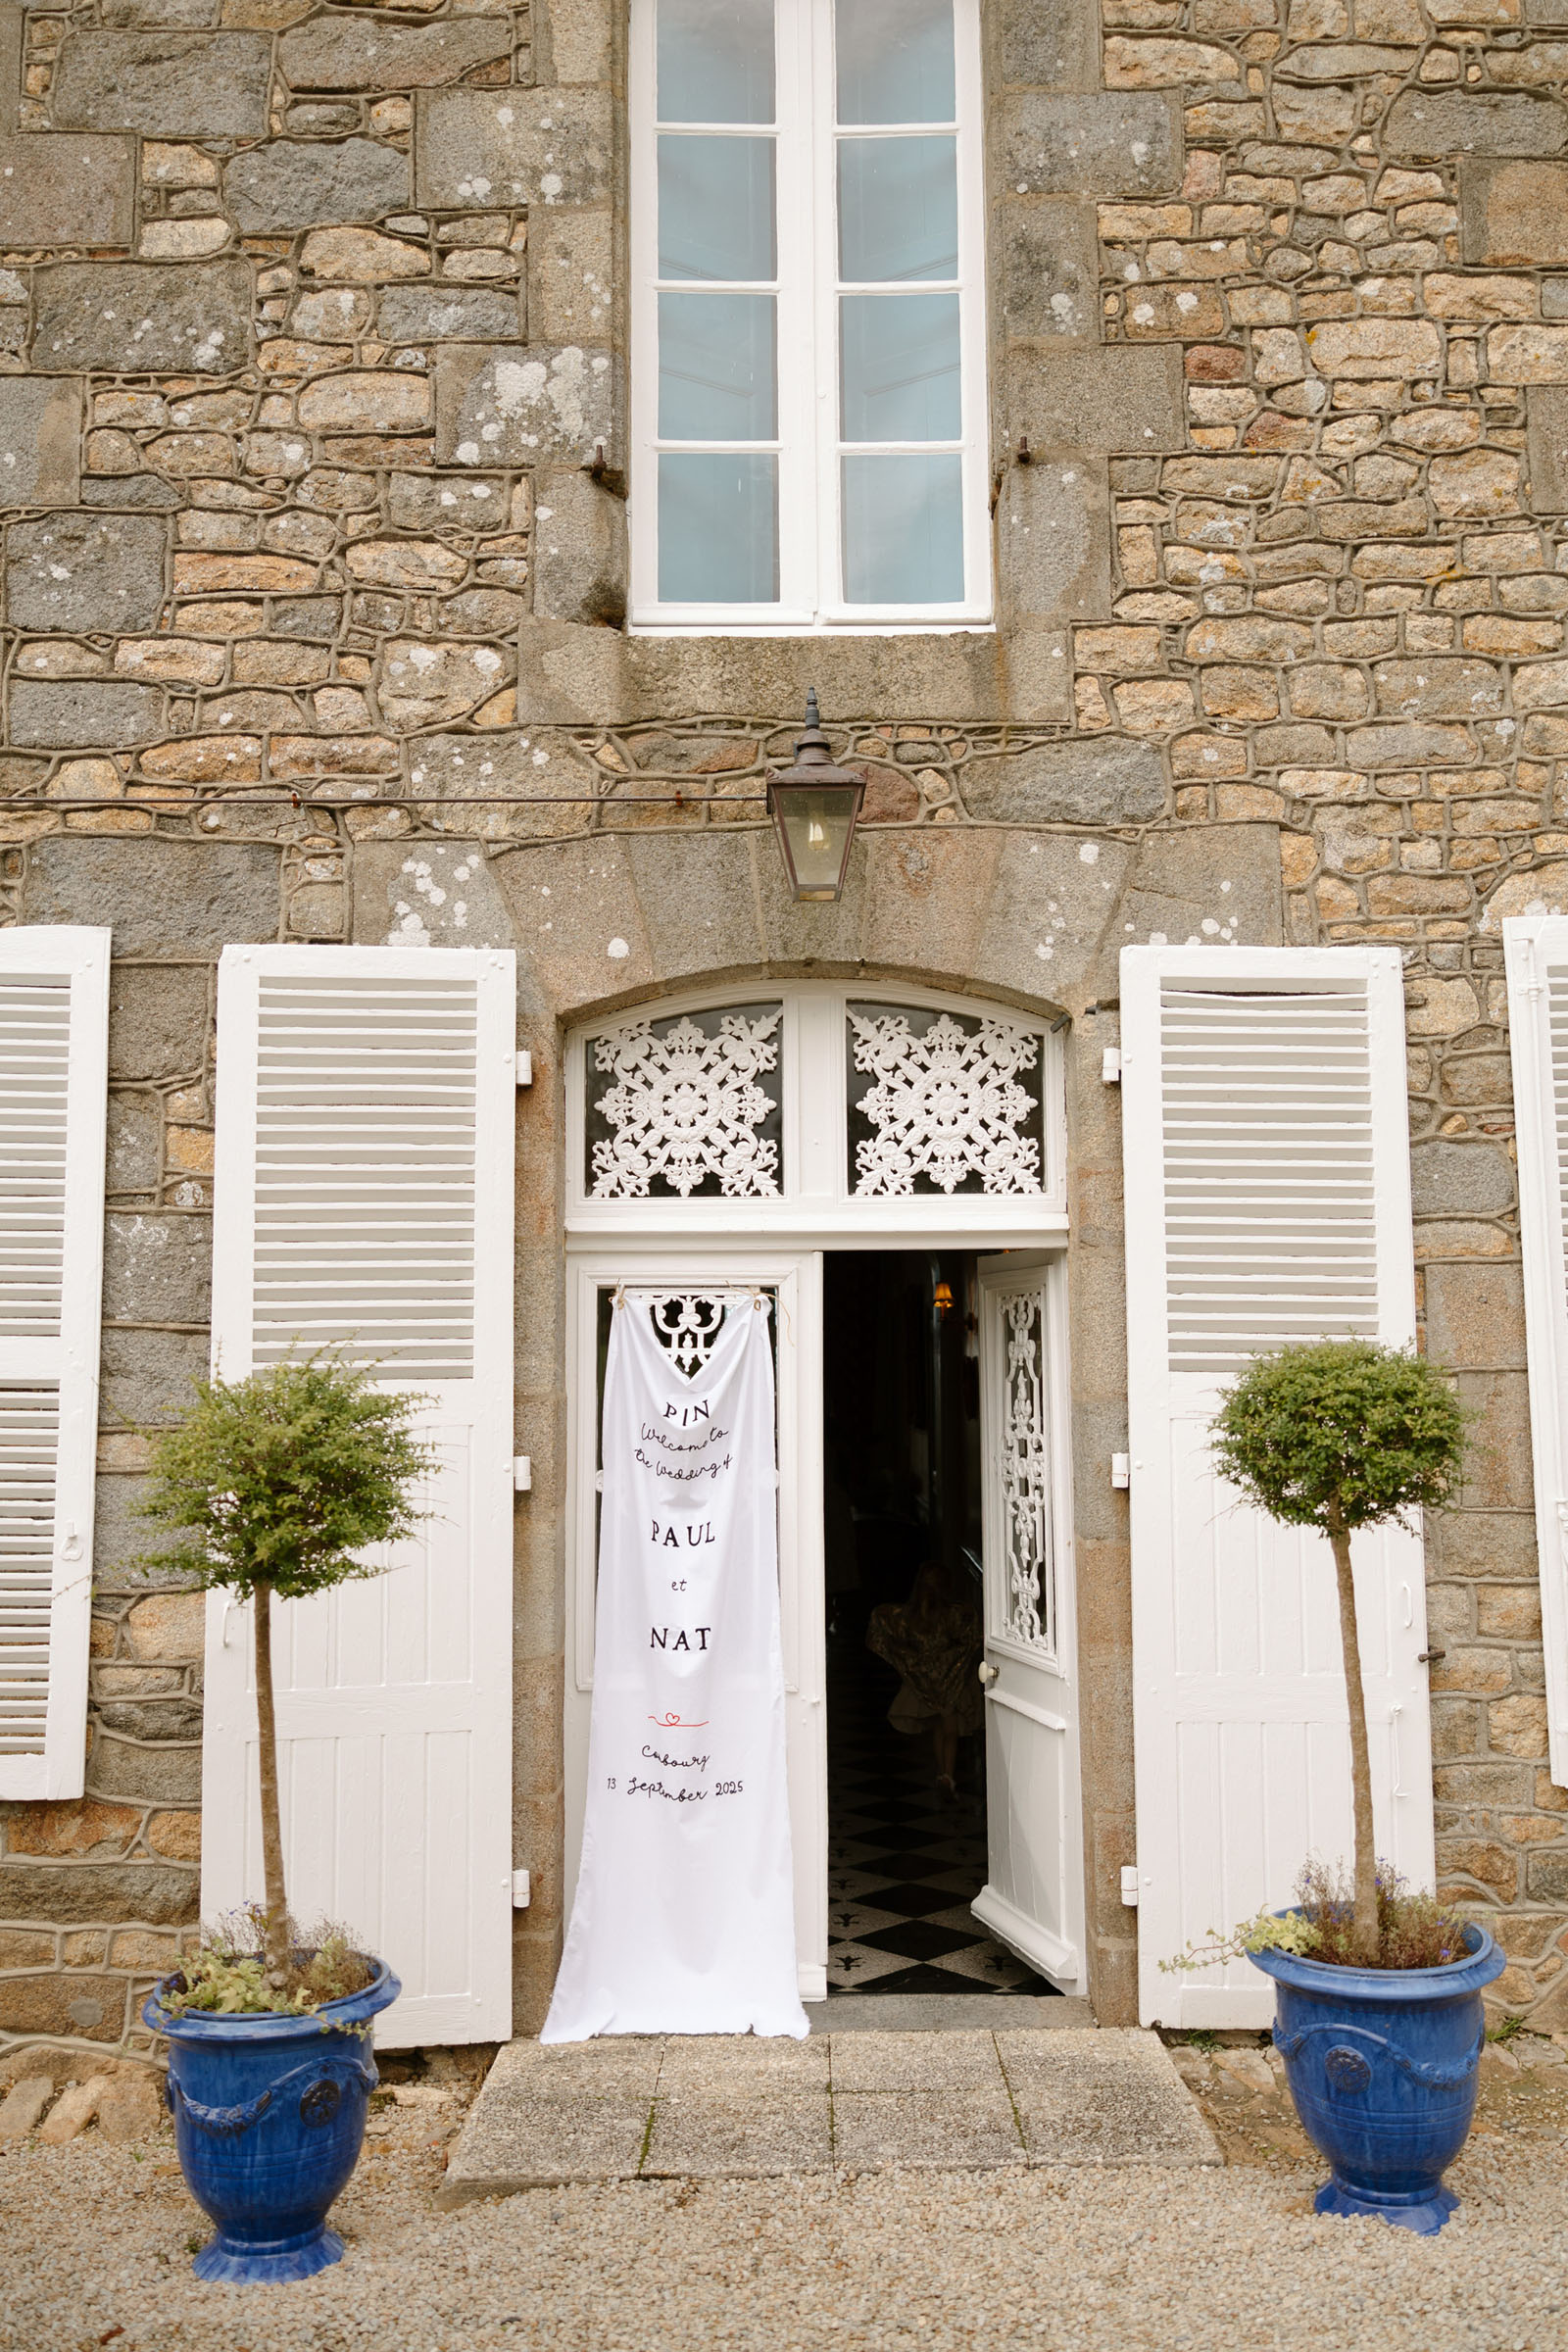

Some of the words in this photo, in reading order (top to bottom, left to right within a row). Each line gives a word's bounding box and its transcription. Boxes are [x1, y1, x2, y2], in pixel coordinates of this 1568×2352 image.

[641, 1422, 709, 1452] Welcome
[710, 1426, 729, 1443] to
[634, 1447, 654, 1469] the
[651, 1519, 715, 1548] PAUL
[671, 1578, 688, 1592] et
[650, 1626, 711, 1651] NAT
[641, 1744, 710, 1773] Cabourg
[607, 1777, 617, 1790] 13
[627, 1776, 709, 1803] September
[714, 1780, 744, 1796] 2025
